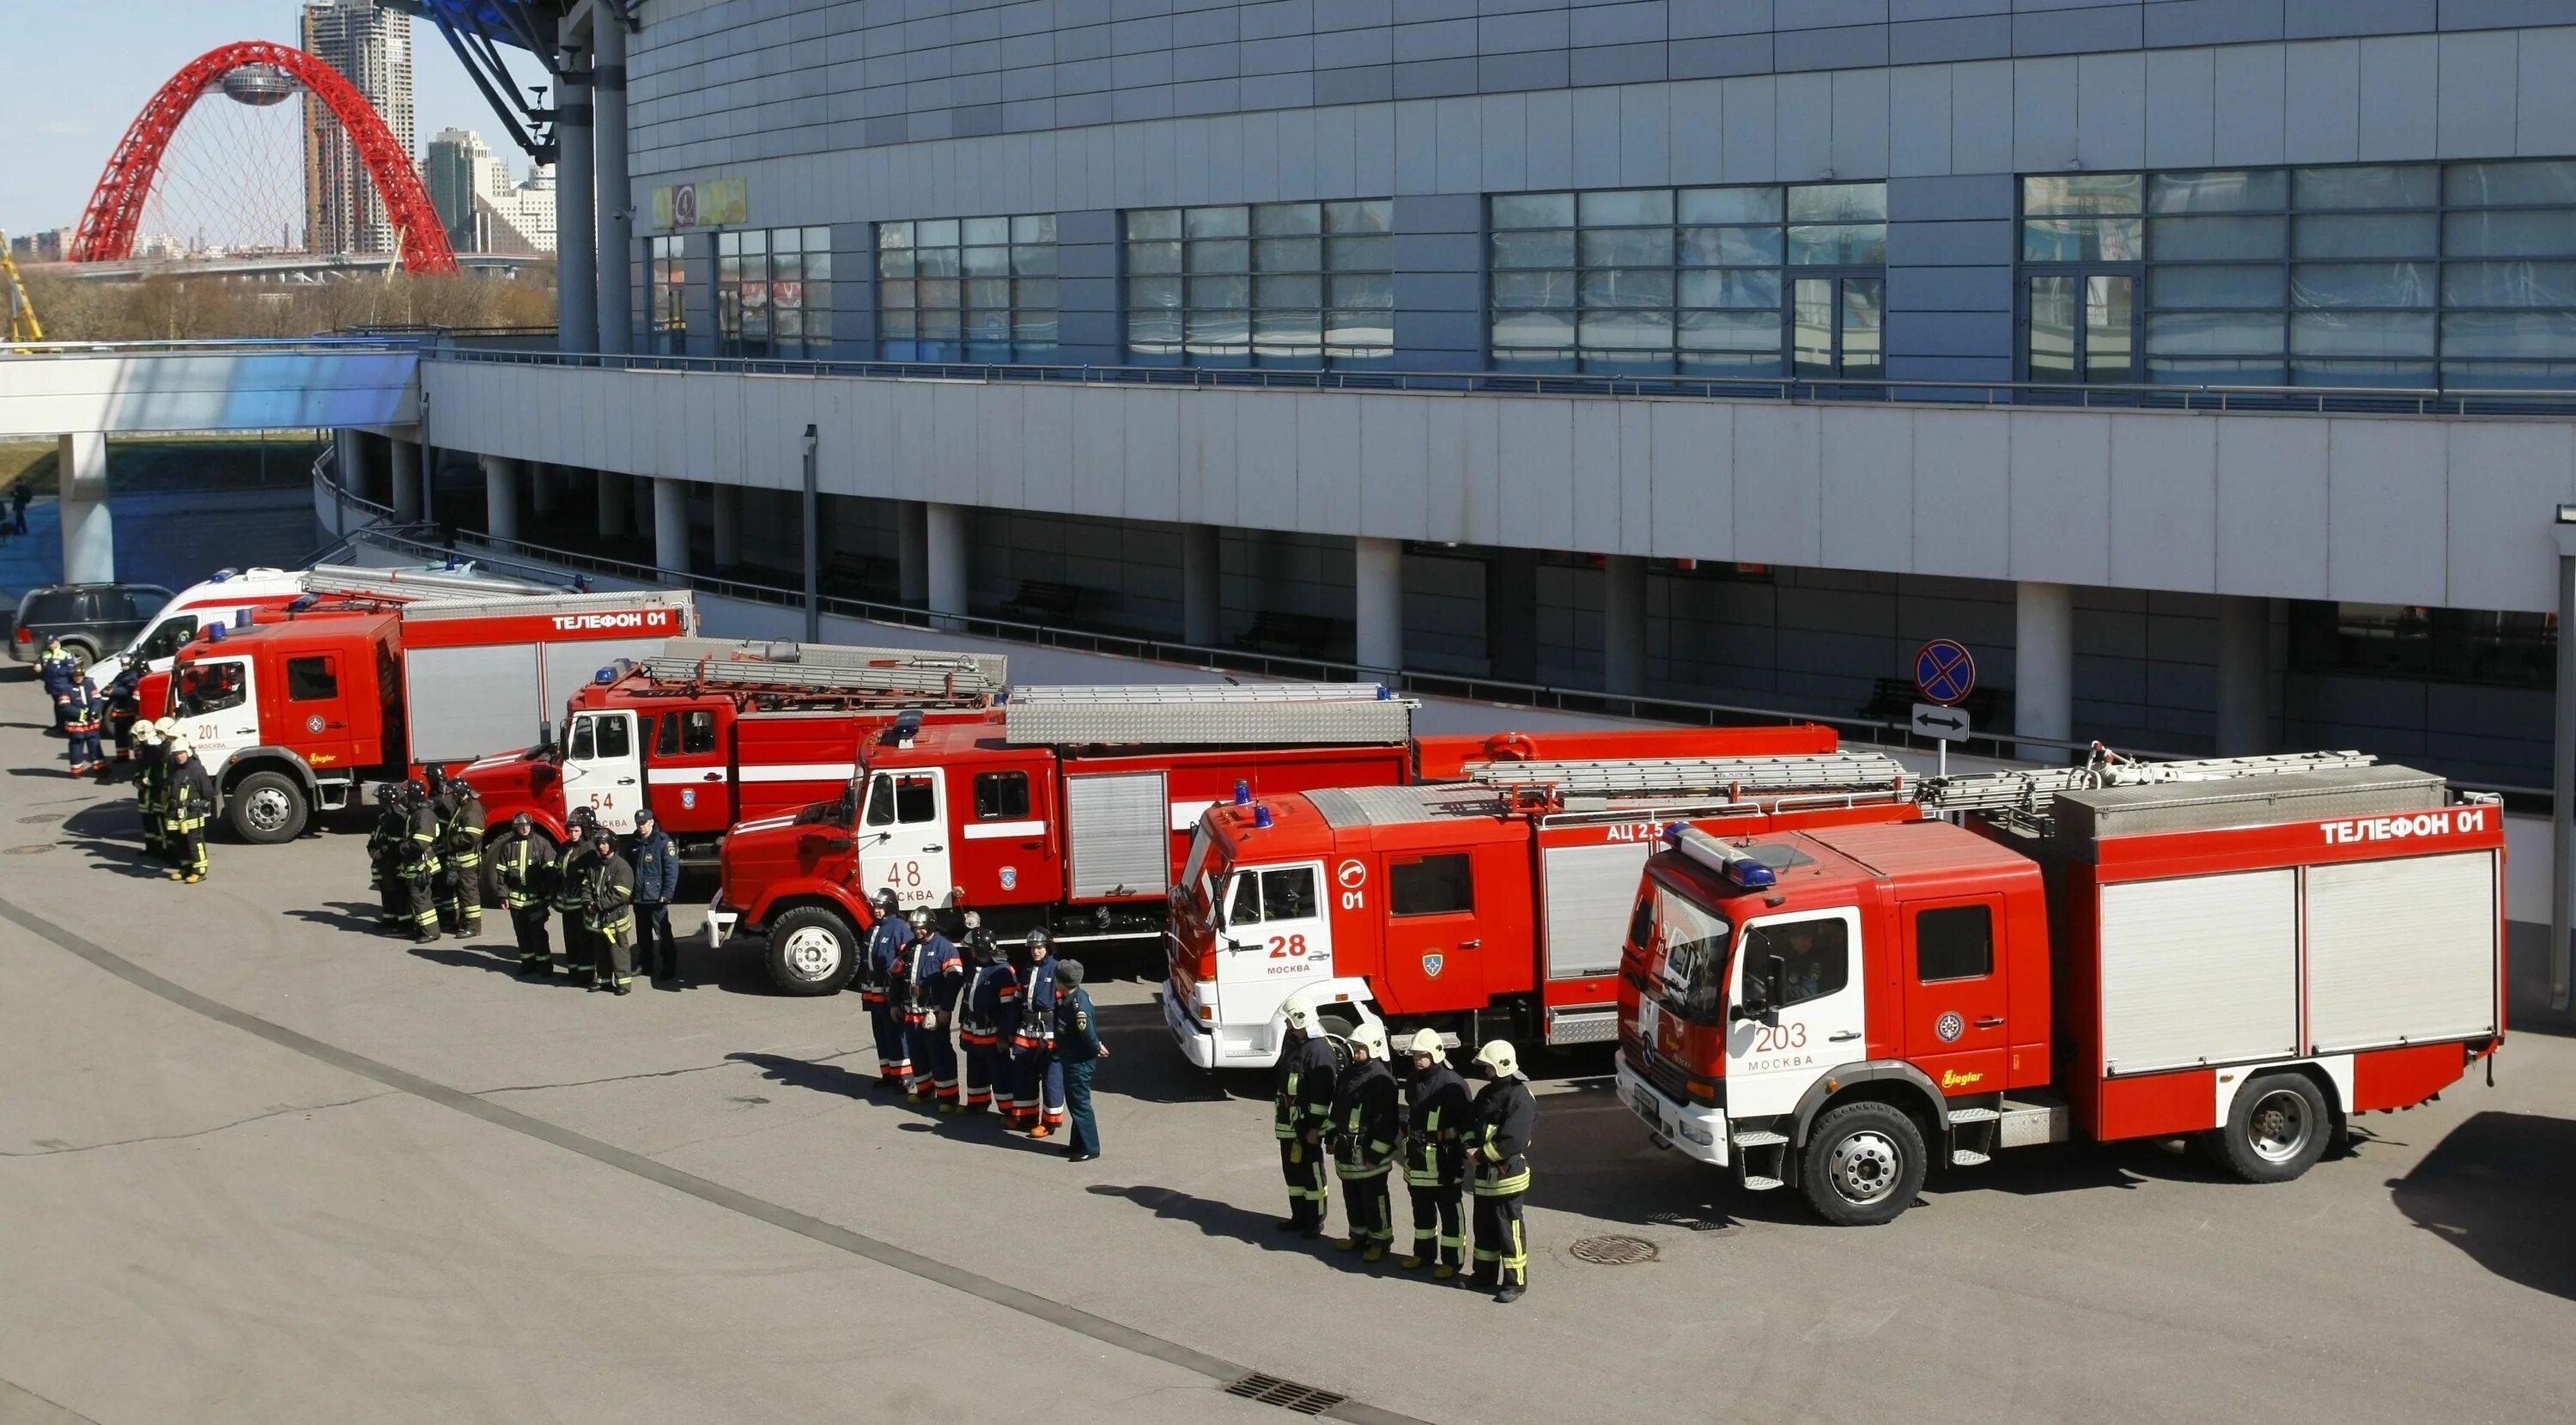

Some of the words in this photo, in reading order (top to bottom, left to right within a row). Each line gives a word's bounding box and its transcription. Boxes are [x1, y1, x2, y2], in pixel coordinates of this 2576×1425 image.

[552, 613, 641, 630] ТЕЛЕФОН
[647, 612, 666, 625] 01
[198, 724, 219, 740] 201
[309, 752, 337, 764] Ziegler
[591, 793, 613, 810] 54
[596, 819, 628, 828] ОСКВА
[2320, 813, 2449, 844] ТЕЛЕФОН
[2457, 810, 2484, 832] 01
[1607, 824, 1634, 842] АЦ
[888, 861, 921, 888] 48
[897, 890, 934, 901] СКВА
[1342, 891, 1364, 910] 01
[1268, 934, 1307, 959] 28
[1267, 964, 1310, 975] МОСКВА
[1755, 1022, 1807, 1052] 203
[1748, 1055, 1814, 1071] МОСКВА
[1941, 1069, 1984, 1088] Ziegler
